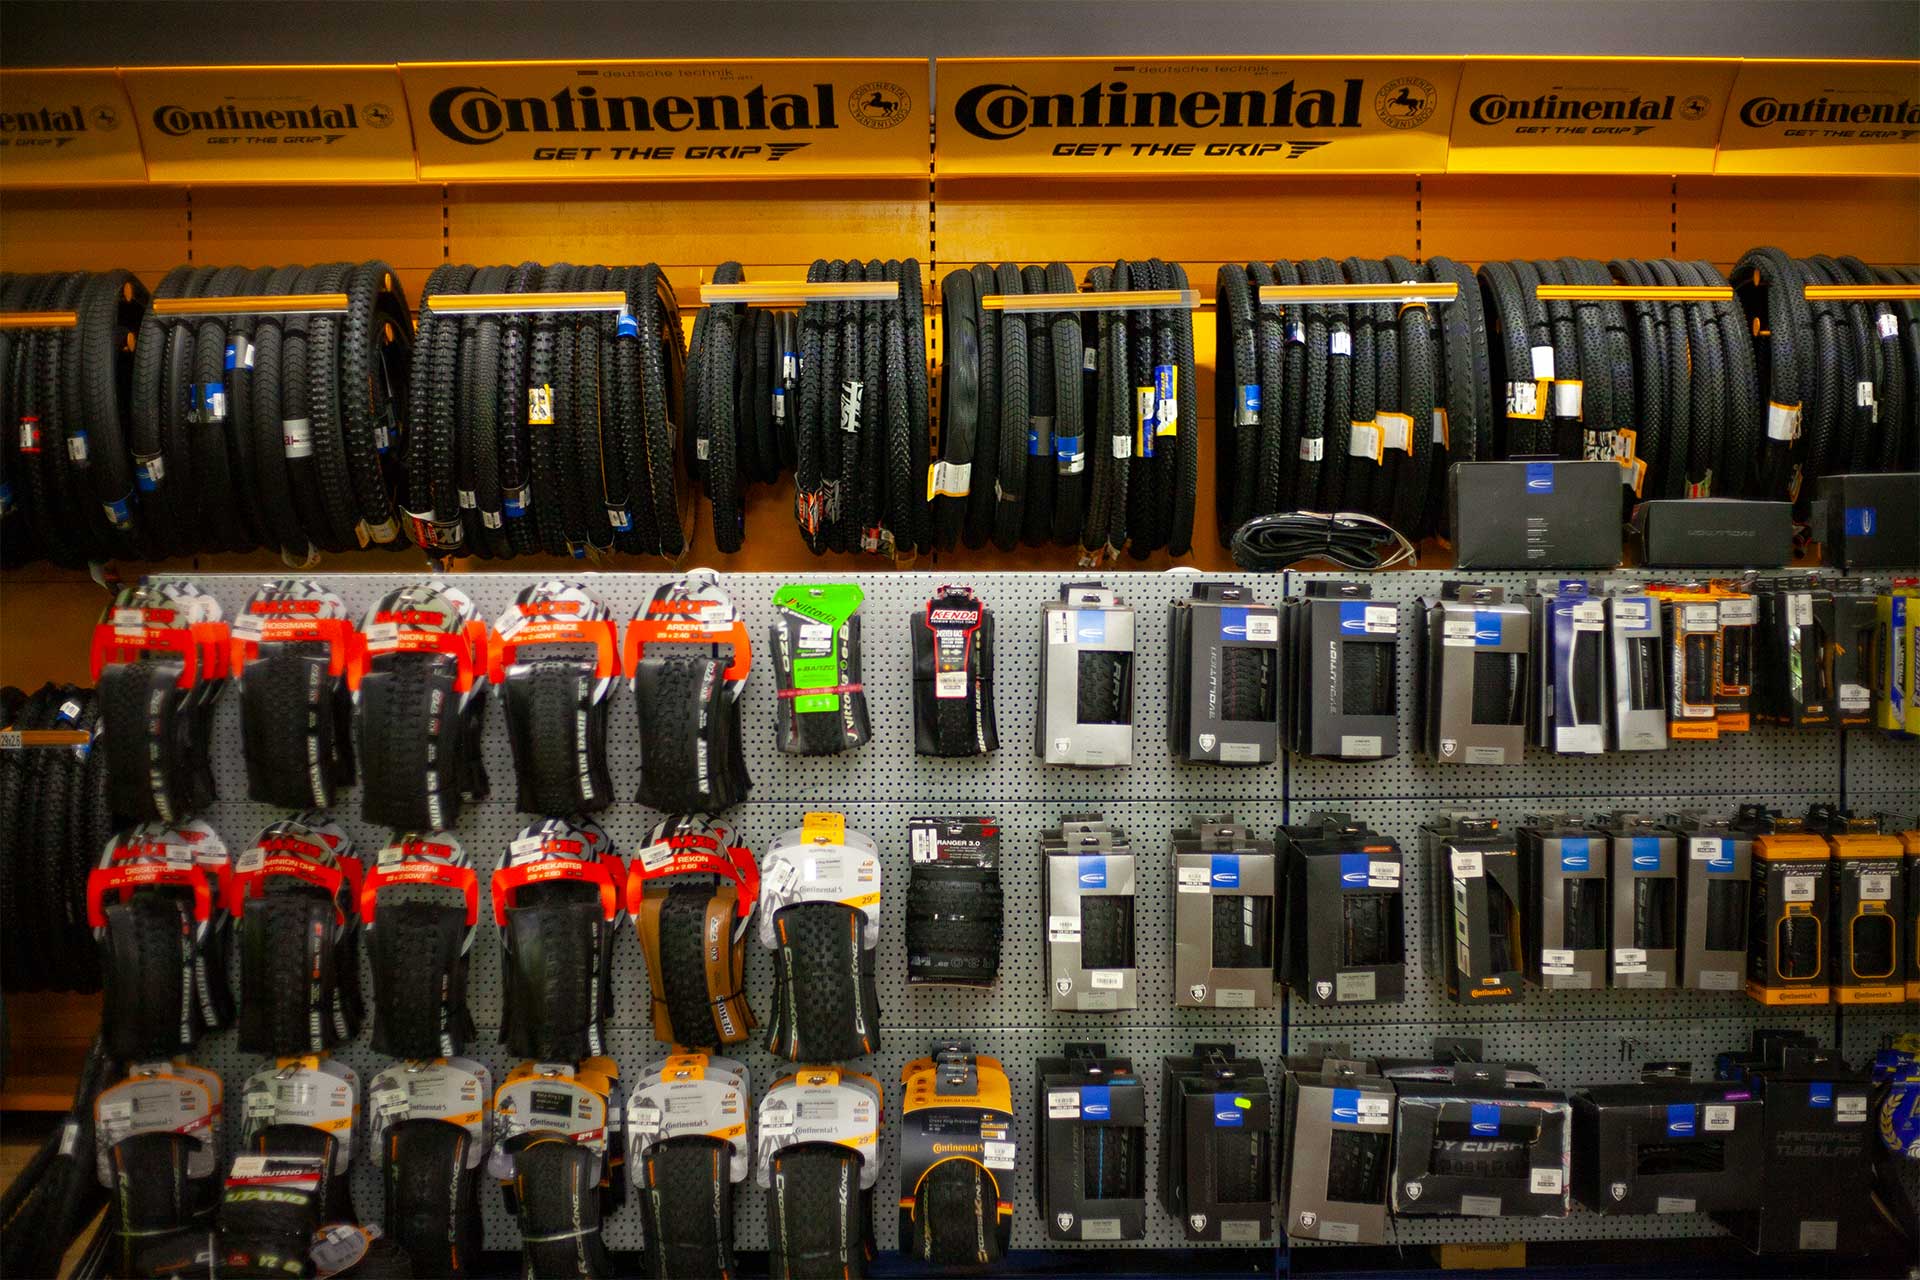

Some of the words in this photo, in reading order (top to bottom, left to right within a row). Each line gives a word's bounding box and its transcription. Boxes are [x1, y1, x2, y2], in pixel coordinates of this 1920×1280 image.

[428, 83, 839, 145] Continental
[954, 78, 1364, 140] Continental
[1469, 93, 1673, 126] Continental
[152, 103, 359, 137] Continental
[1515, 126, 1549, 134] GET
[1553, 126, 1586, 134] THE
[1592, 125, 1632, 135] GRIP
[1783, 129, 1818, 137] GET
[1859, 130, 1898, 138] GRIP
[246, 136, 279, 144] THE
[283, 136, 323, 144] GRIP
[533, 147, 601, 161] GET
[610, 147, 676, 160] THE
[685, 145, 762, 160] GRIP
[1052, 143, 1122, 156] GET
[1130, 143, 1195, 156] THE
[1204, 142, 1283, 156] GRIP
[795, 602, 838, 623] vittoria
[930, 609, 978, 621] KENDA
[263, 621, 317, 629] ROSSMARK
[933, 1143, 978, 1154] Continental
